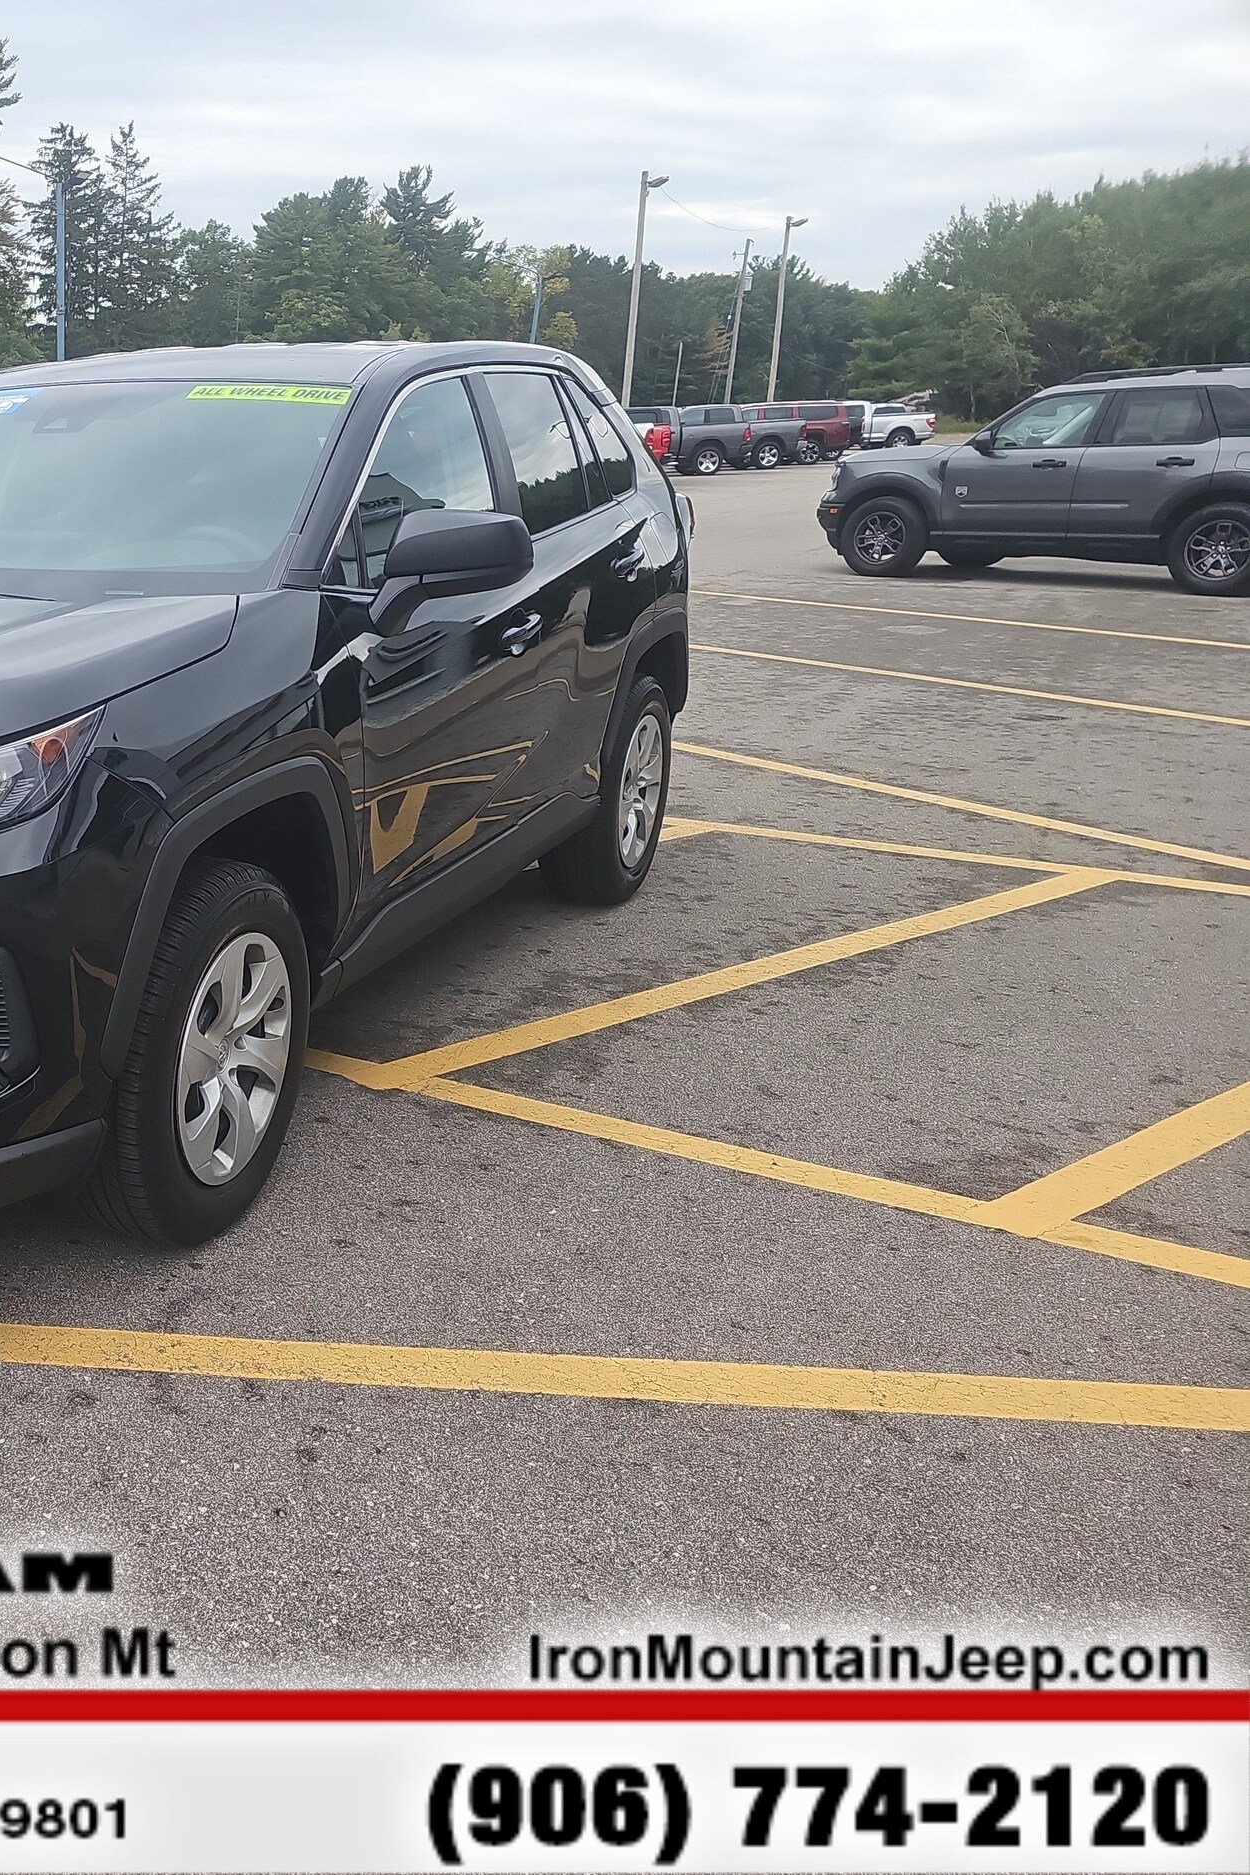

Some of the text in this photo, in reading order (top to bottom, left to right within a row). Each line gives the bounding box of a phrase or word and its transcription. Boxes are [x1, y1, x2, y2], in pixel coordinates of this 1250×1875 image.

[193, 387, 348, 400] ALL WHEEL DRIVE
